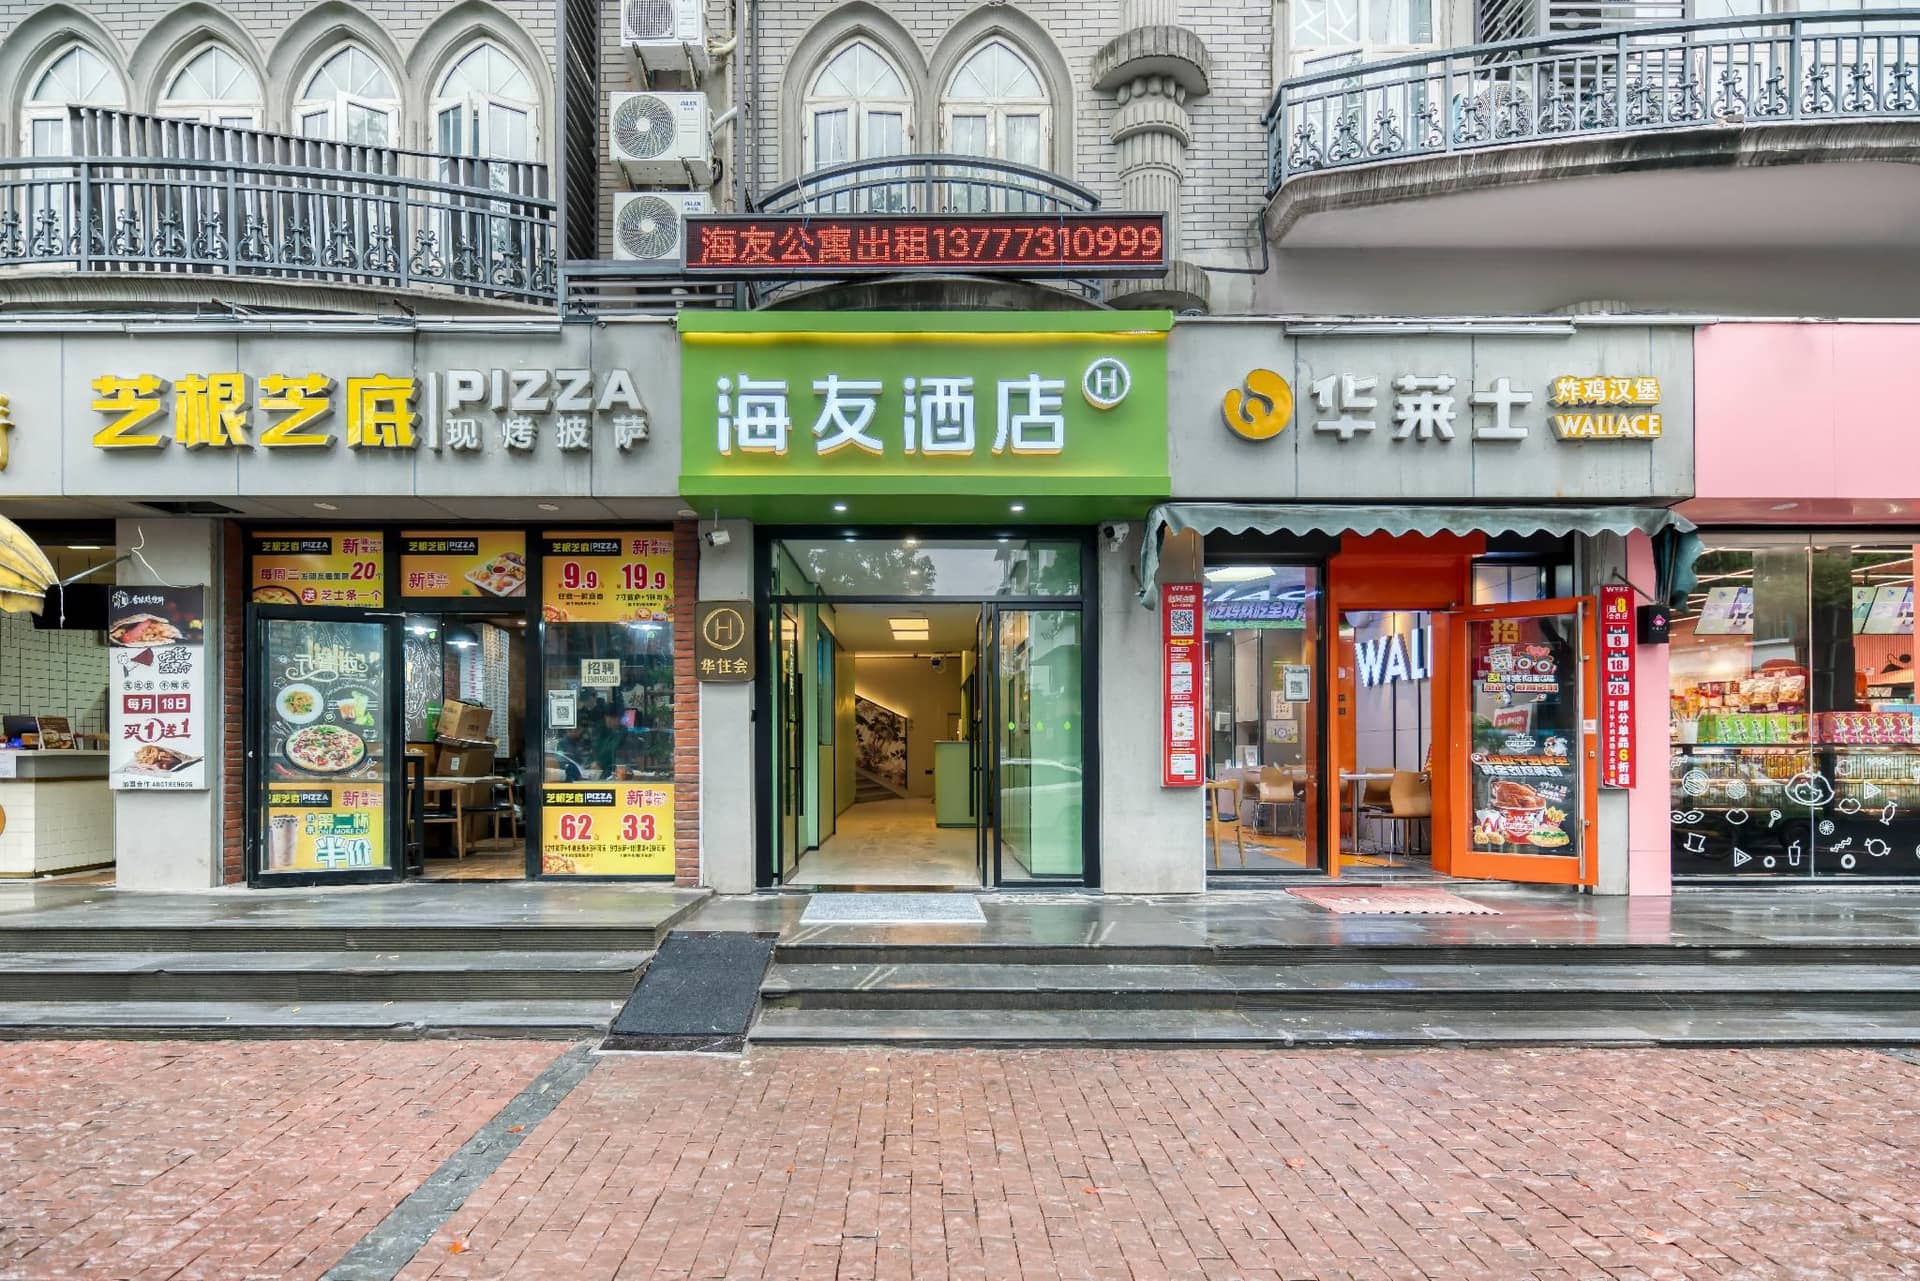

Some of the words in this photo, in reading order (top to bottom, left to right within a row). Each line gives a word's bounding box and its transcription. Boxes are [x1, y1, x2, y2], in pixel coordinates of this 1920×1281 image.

[701, 225, 1162, 263] 海友公寓出租13777310999
[447, 368, 648, 413] PIZZA
[1557, 376, 1660, 402] 炸鸡汉堡
[91, 373, 420, 449] 芝根芝底
[716, 372, 1066, 456] 海友酒店
[1310, 372, 1533, 443] 华莱士
[446, 415, 648, 450] 现烤披萨
[1557, 414, 1661, 438] WALLACE
[302, 541, 328, 549] PIZZA
[342, 538, 359, 556] 新
[449, 541, 475, 549] PIZZA
[592, 541, 619, 550] PIZZA
[632, 539, 650, 557] 新
[350, 561, 376, 580] 20
[564, 562, 597, 589] 9.9
[622, 564, 666, 590] 19.9
[408, 572, 426, 590] 新
[320, 589, 382, 601] 芝士条一个
[1490, 619, 1519, 643] 招
[1614, 636, 1622, 647] 8
[587, 661, 615, 675] 招聘
[701, 657, 748, 675] 华住会
[1610, 659, 1624, 671] 18
[1610, 683, 1624, 695] 28
[128, 698, 153, 711] 每月
[162, 697, 187, 710] 18日
[124, 718, 192, 742] 买1送1
[1617, 700, 1630, 785] 部分单品6折起
[303, 793, 328, 801] PIZZA
[342, 791, 360, 808] 新
[627, 789, 644, 808] 新
[318, 813, 369, 829] 第二杯
[560, 814, 593, 841] 62
[622, 814, 656, 841] 33
[315, 835, 371, 869] 半价
